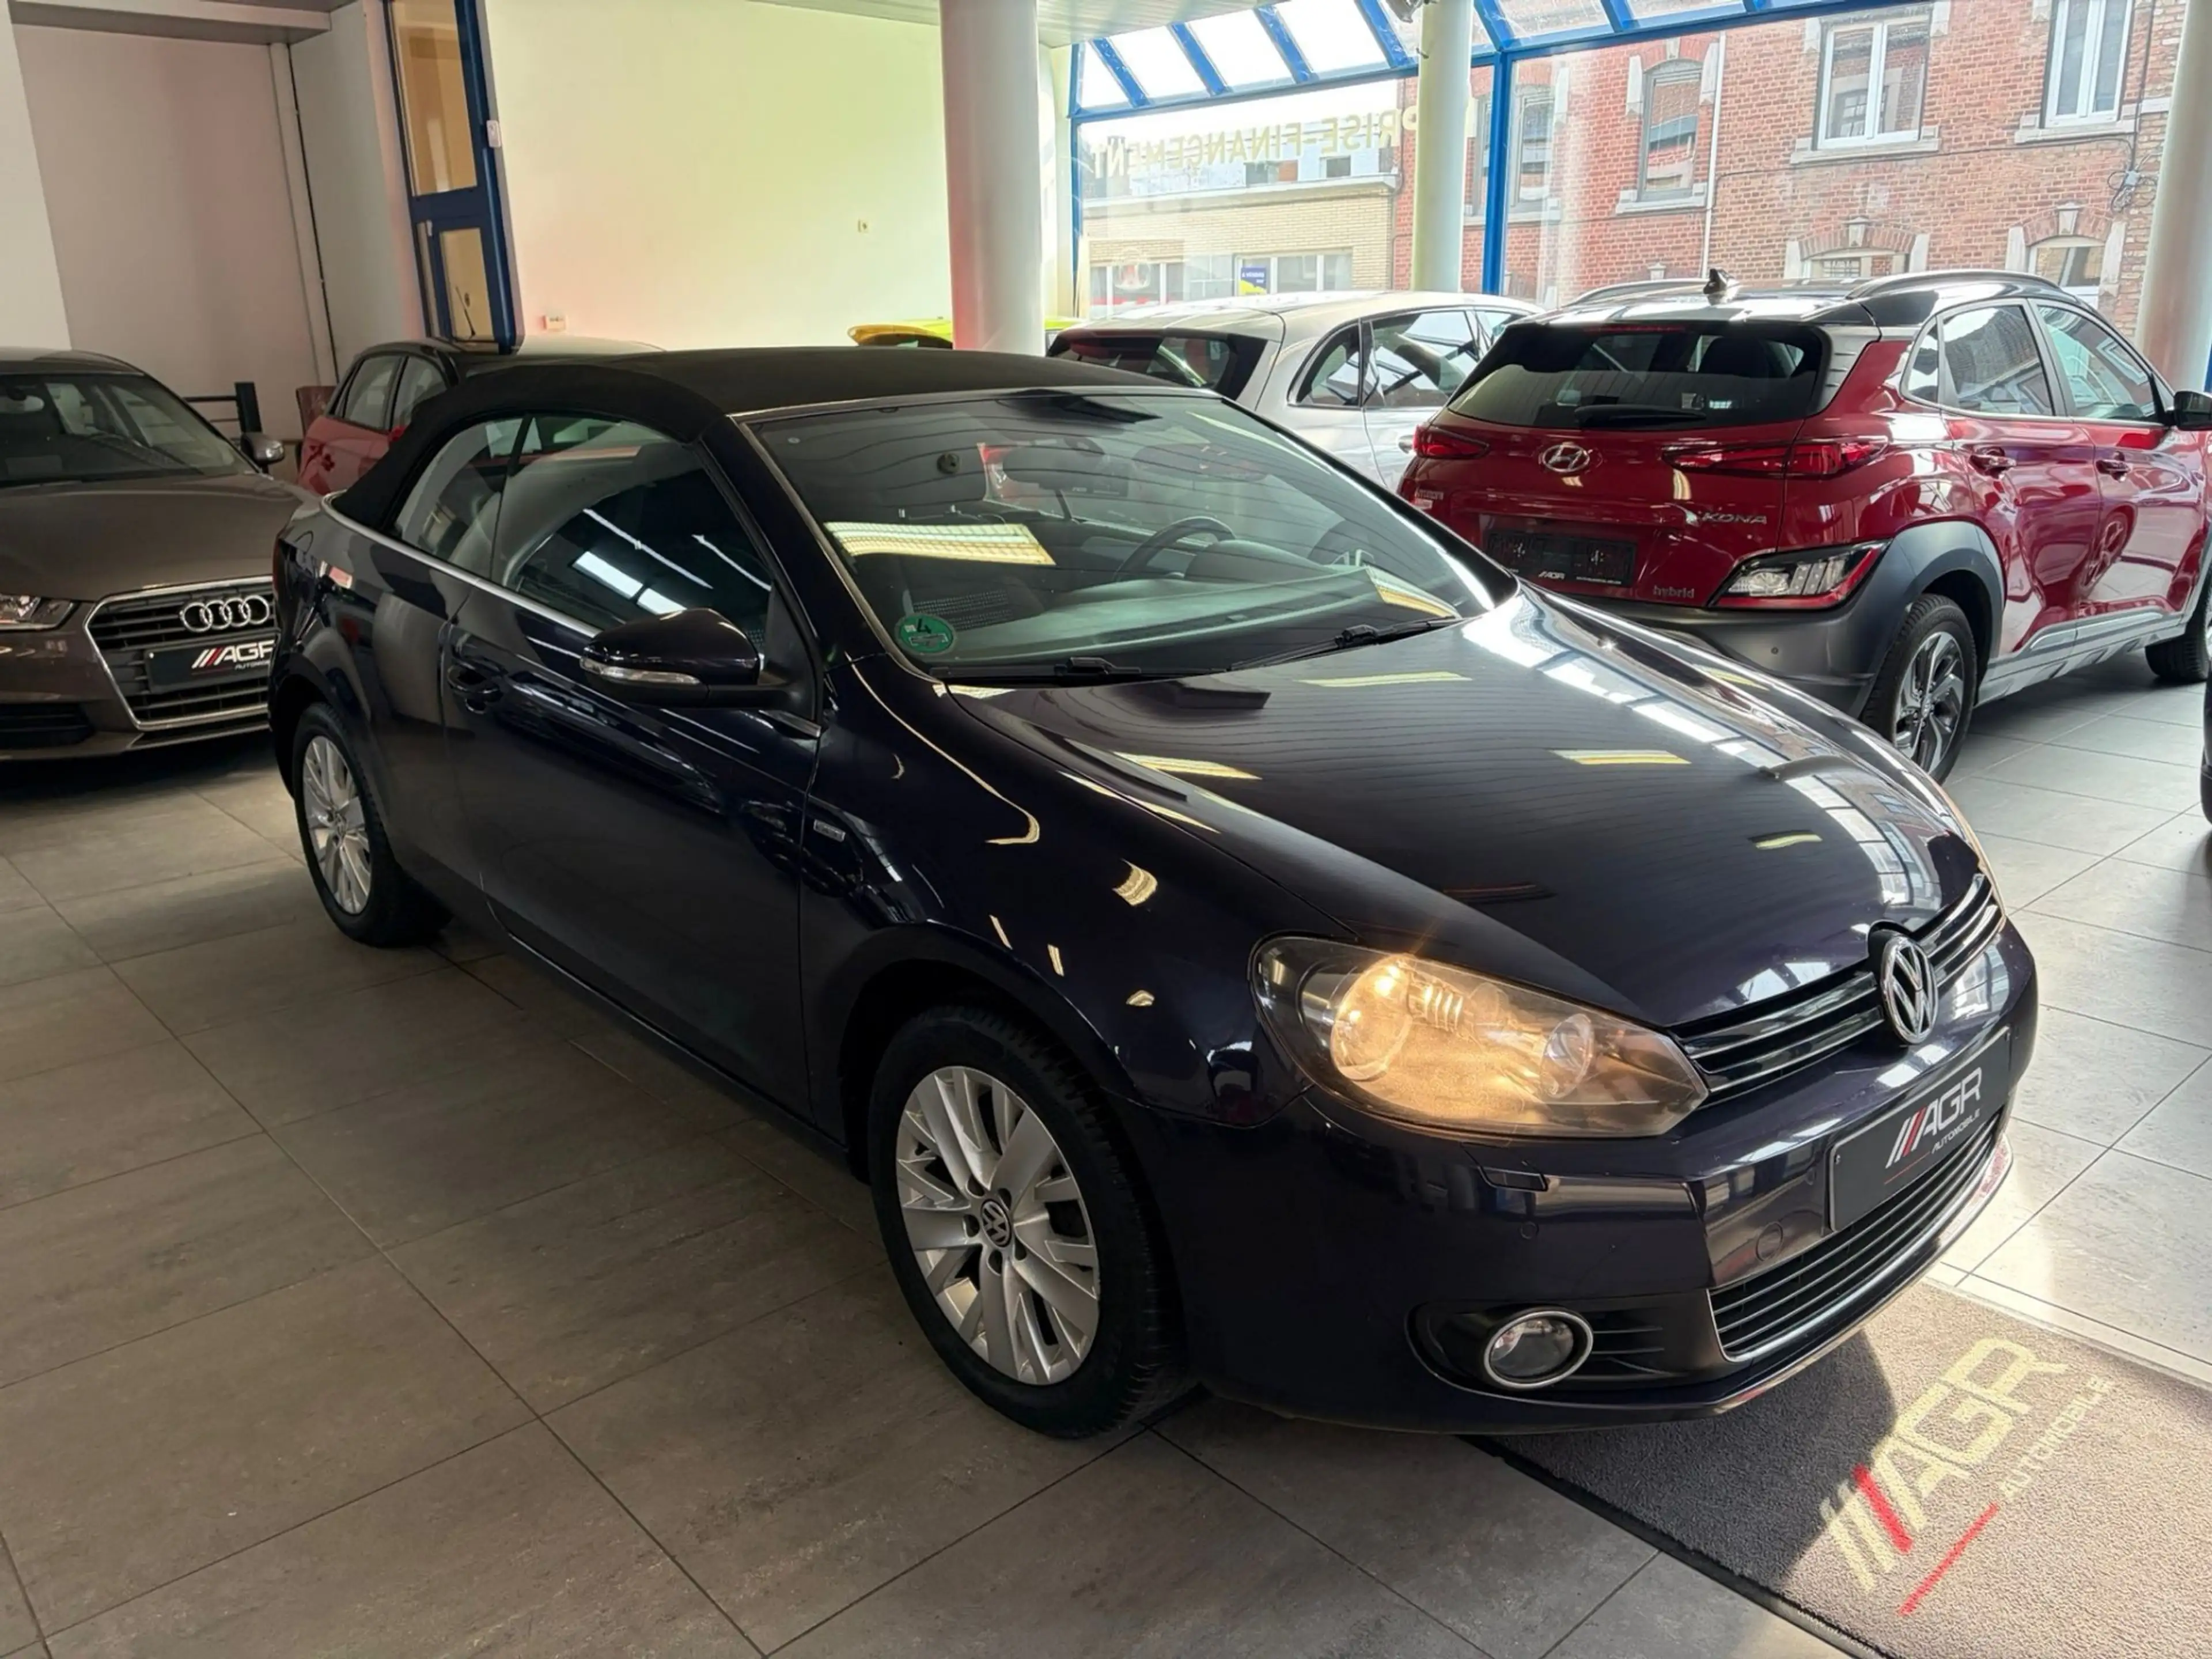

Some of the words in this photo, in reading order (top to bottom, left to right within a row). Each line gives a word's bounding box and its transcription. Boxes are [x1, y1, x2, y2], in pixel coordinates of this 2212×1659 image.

[1702, 512, 1767, 524] KONA
[1653, 585, 1695, 599] hybrid
[1912, 1067, 1982, 1152] AGR
[1870, 1337, 2069, 1532] AGR
